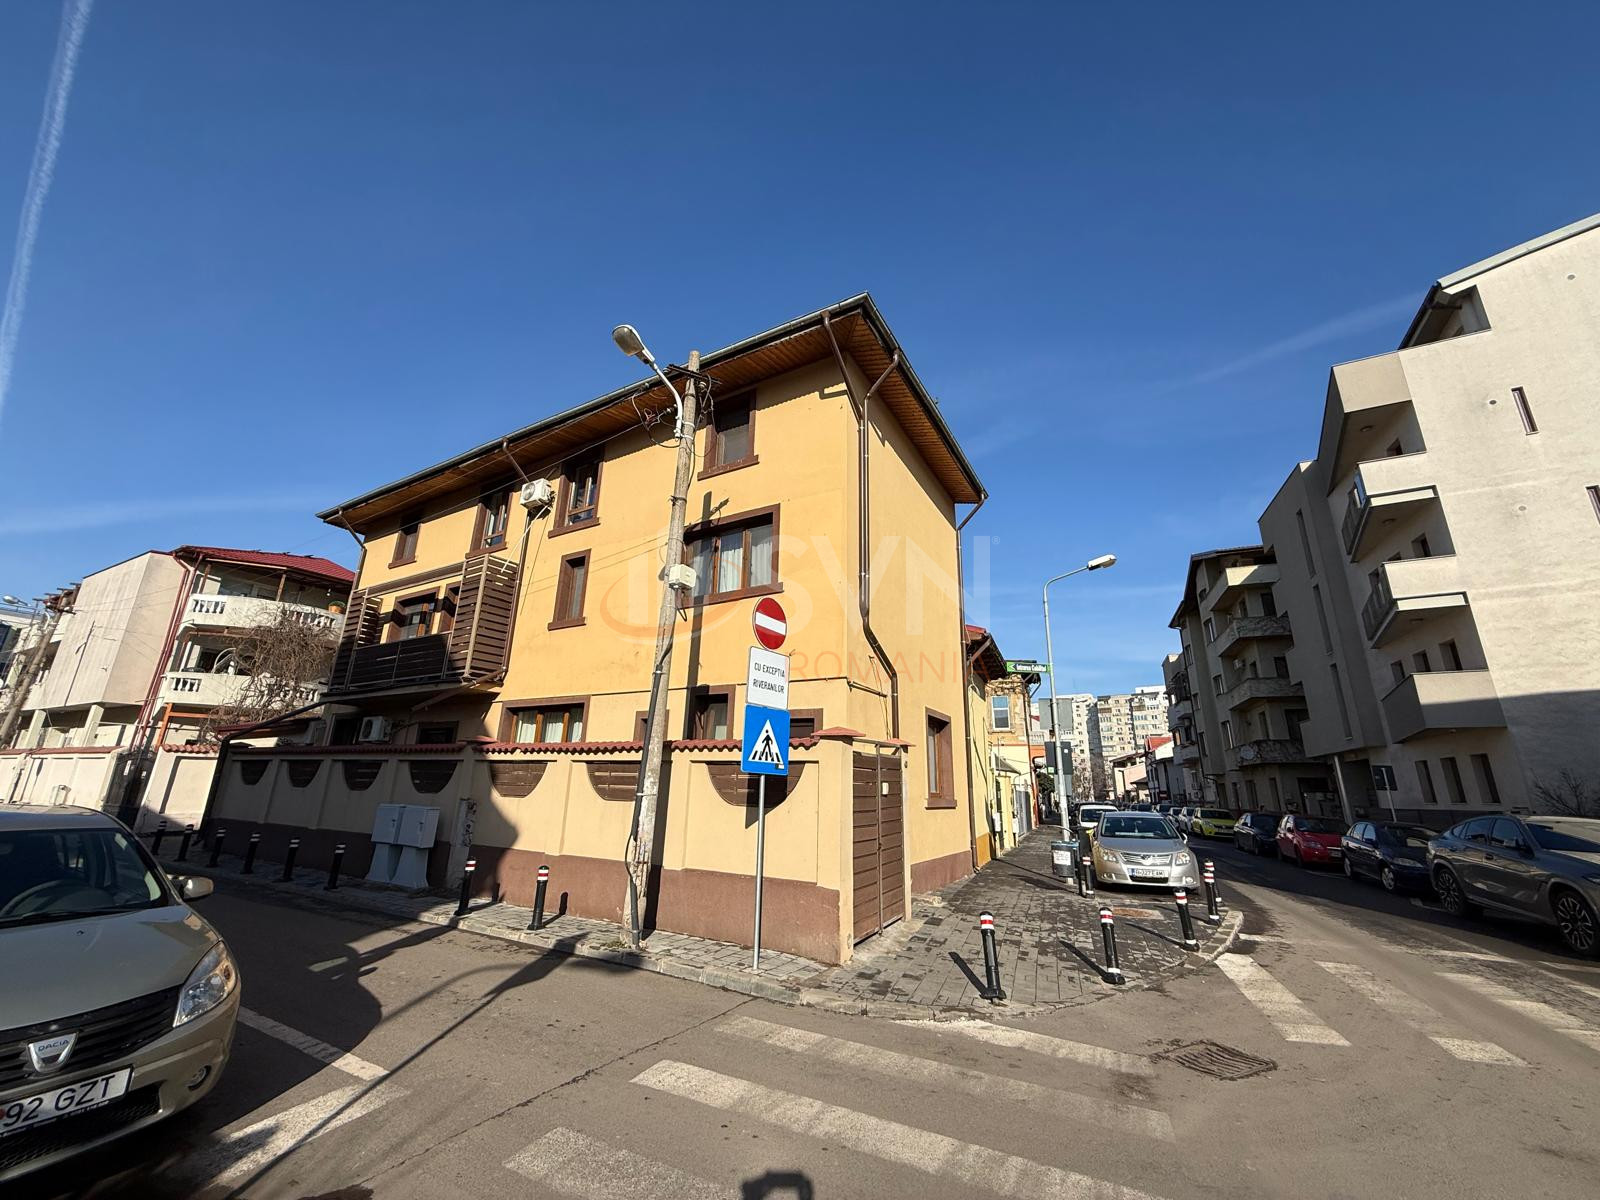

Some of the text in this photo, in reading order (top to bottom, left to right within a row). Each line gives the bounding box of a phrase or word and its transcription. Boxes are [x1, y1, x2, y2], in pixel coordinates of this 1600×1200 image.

[754, 662, 785, 678] CU EXCEPTIA
[752, 678, 785, 694] RIVERANILOR
[38, 1039, 69, 1052] DACIA
[3, 1096, 43, 1127] 92
[54, 1074, 116, 1112] GZT
